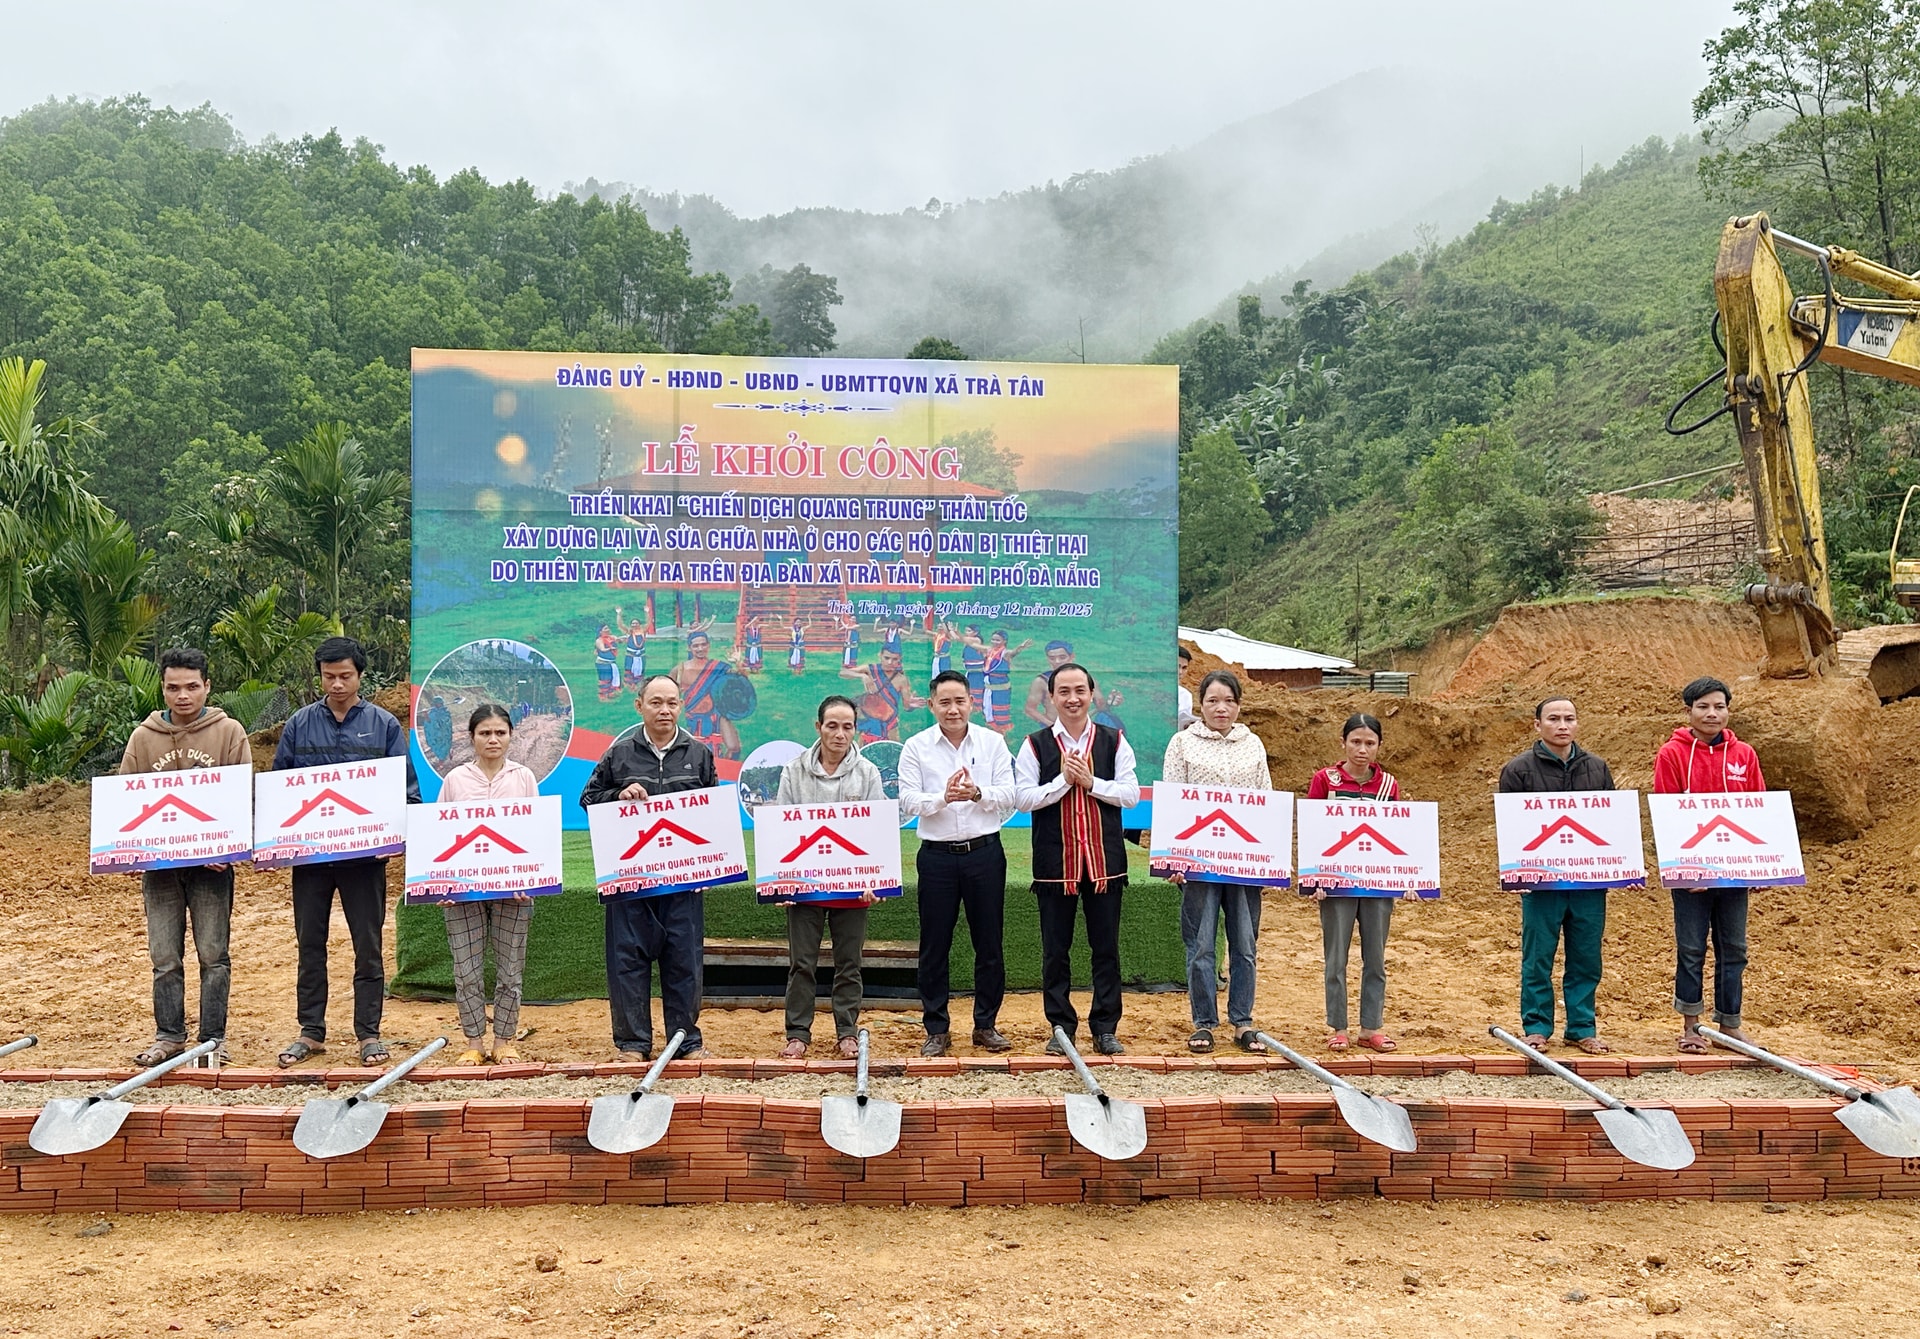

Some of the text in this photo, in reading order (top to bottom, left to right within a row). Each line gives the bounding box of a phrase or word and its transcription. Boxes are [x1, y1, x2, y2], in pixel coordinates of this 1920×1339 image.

[1860, 330, 1887, 347] Yutani
[557, 364, 612, 387] ĐẢNG
[620, 365, 645, 387] UỶ
[668, 371, 722, 388] HĐND
[746, 373, 798, 390] UBND
[822, 375, 927, 394] UBMTTQVN
[935, 374, 958, 393] XÃ
[965, 374, 1000, 395] TRÀ
[1008, 374, 1044, 396] TÂN
[643, 425, 961, 480] LỄ KHỞI CÔNG
[570, 488, 1027, 522] TRIỂN KHAI “CHIẾN DỊCH QUANG TRUNG” THẦN TỐC
[504, 523, 1088, 558] XÂY DỰNG LẠI VÀ SỬA CHỮA NHÀ Ở CHO CÁC HỘ DÂN BỊ THIỆT HẠI
[492, 558, 1098, 588] DO THIÊN TAI GÂY RA TRÊN ĐỊA BÀN XÃ TRÀ TÂN, THÀNH PHỐ ĐÀ NẴNG
[828, 600, 1092, 618] Trà Tân, ngày 20 tháng 12 năm 2025
[152, 748, 215, 771] DAFFY DUCK
[125, 771, 221, 791] XÃ TRÀ TÂN
[285, 765, 376, 787] XÃ TRÀ TÂN
[618, 793, 709, 818] XÃ TRÀ TÂN
[1181, 787, 1266, 806] XÃ TRÀ TÂN
[1523, 795, 1611, 810] XÃ TRÀ TÂN
[1677, 795, 1764, 809] XÃ TRÀ TÂN
[439, 802, 532, 820] XÃ TRÀ TÂN
[783, 804, 870, 821] XÃ TRÀ TÂN
[1325, 803, 1410, 818] XÃ TRÀ TÂN
[110, 830, 234, 849] “CHIẾN DỊCH QUANG TRUNG”
[272, 823, 389, 844] “CHIẾN DỊCH QUANG TRUNG”
[1167, 845, 1275, 864] “CHIẾN DỊCH QUANG TRUNG”
[1516, 856, 1627, 869] “CHIẾN DỊCH QUANG TRUNG”
[1674, 854, 1785, 866] “CHIẾN DỊCH QUANG TRUNG”
[425, 863, 544, 879] “CHIẾN DỊCH QUANG TRUNG”
[613, 852, 728, 877] “CHIẾN DỊCH QUANG TRUNG”
[773, 865, 884, 880] “CHIẾN DỊCH QUANG TRUNG”
[1314, 862, 1423, 876] “CHIẾN DỊCH QUANG TRUNG”
